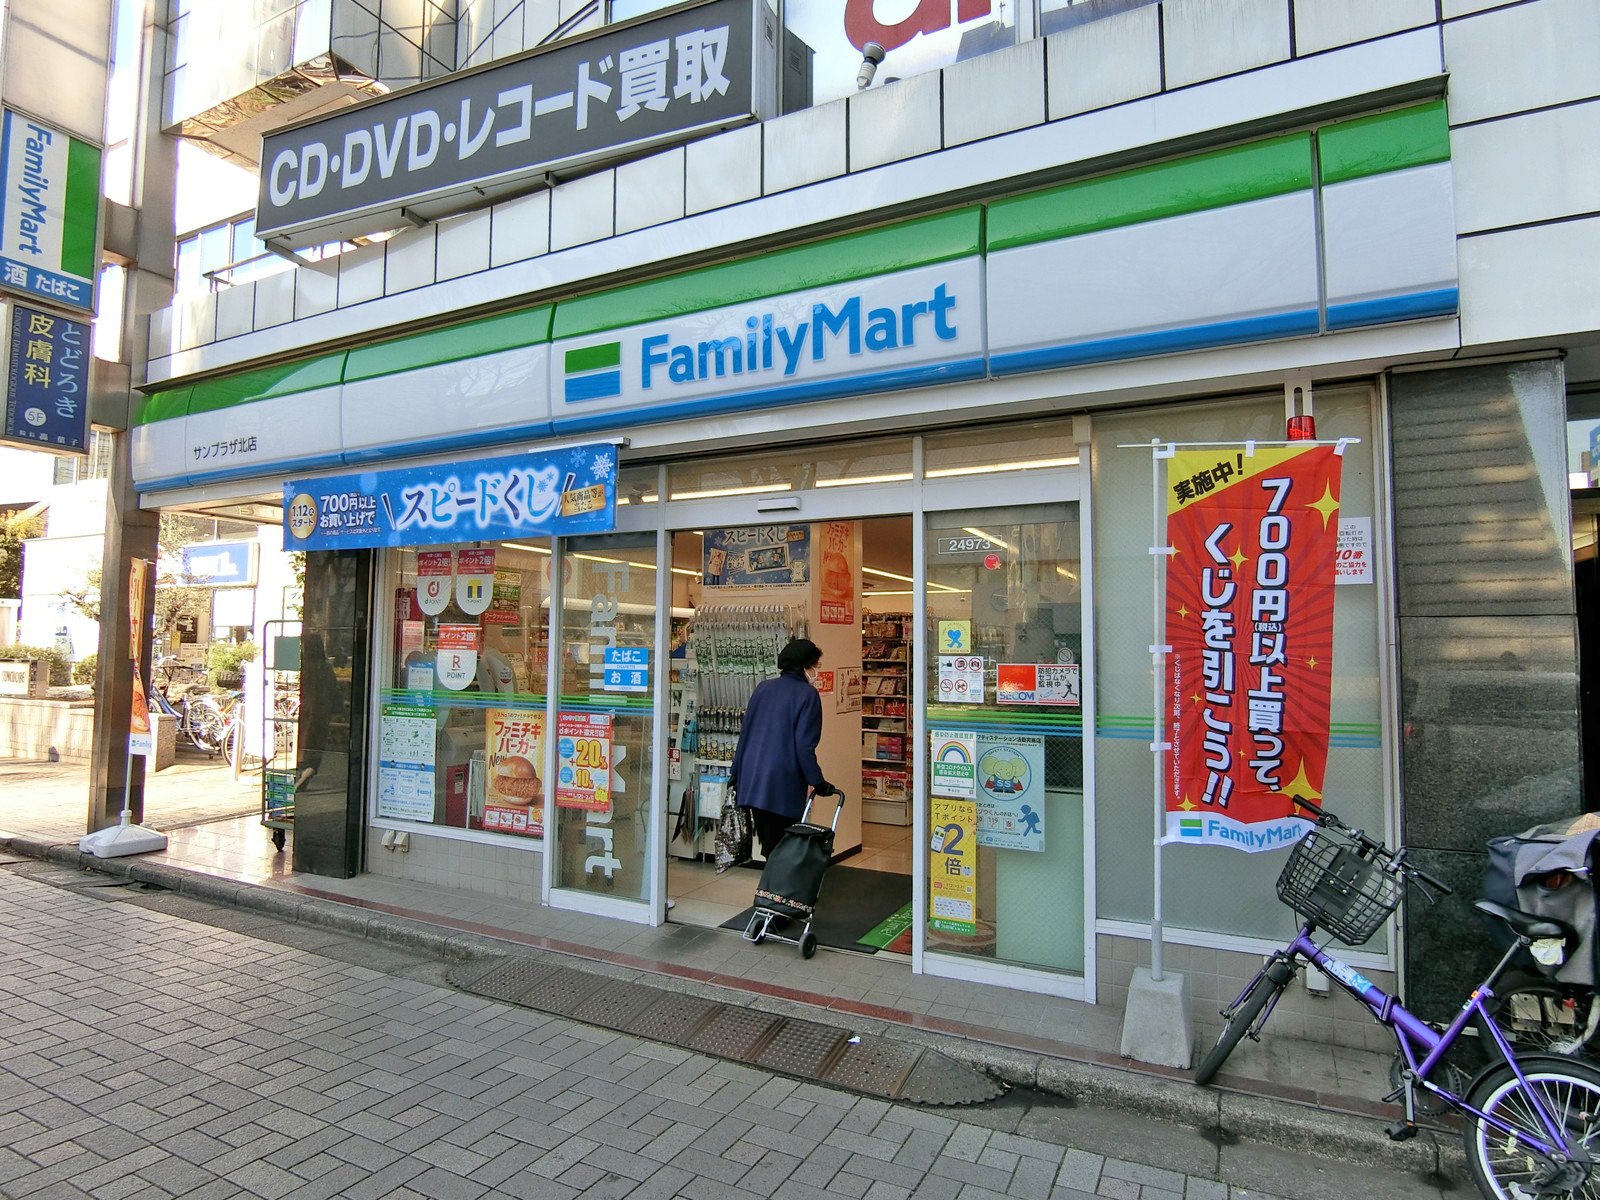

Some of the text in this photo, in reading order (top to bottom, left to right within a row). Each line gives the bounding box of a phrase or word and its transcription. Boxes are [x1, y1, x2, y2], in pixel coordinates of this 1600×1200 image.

[18, 122, 52, 256] FamilyMart
[4, 260, 80, 301] 酒 たばこ
[641, 281, 957, 390] FamilyMart
[24, 313, 55, 389] 皮膚科
[55, 322, 82, 419] とどろき
[27, 410, 44, 422] 5F
[193, 437, 257, 461] サンプラザ北店
[1173, 453, 1246, 504] 実施中!
[320, 493, 377, 513] 700円以上
[400, 472, 555, 525] スピードくじ
[291, 518, 314, 528] スタート
[319, 511, 376, 528] お買い上げで
[725, 526, 787, 543] スピードくじ
[949, 538, 991, 551] 24973
[439, 631, 477, 642] ポイント2倍!
[611, 650, 642, 663] たばこ
[1038, 667, 1078, 675] 防犯カメラで
[1038, 674, 1067, 682] セコムが
[1000, 691, 1034, 701] SECOM
[494, 721, 541, 741] ファミチキ
[498, 738, 537, 755] バーガー
[996, 780, 1011, 788] SS
[934, 802, 973, 814] アプリなら
[935, 812, 973, 823] Tポイント
